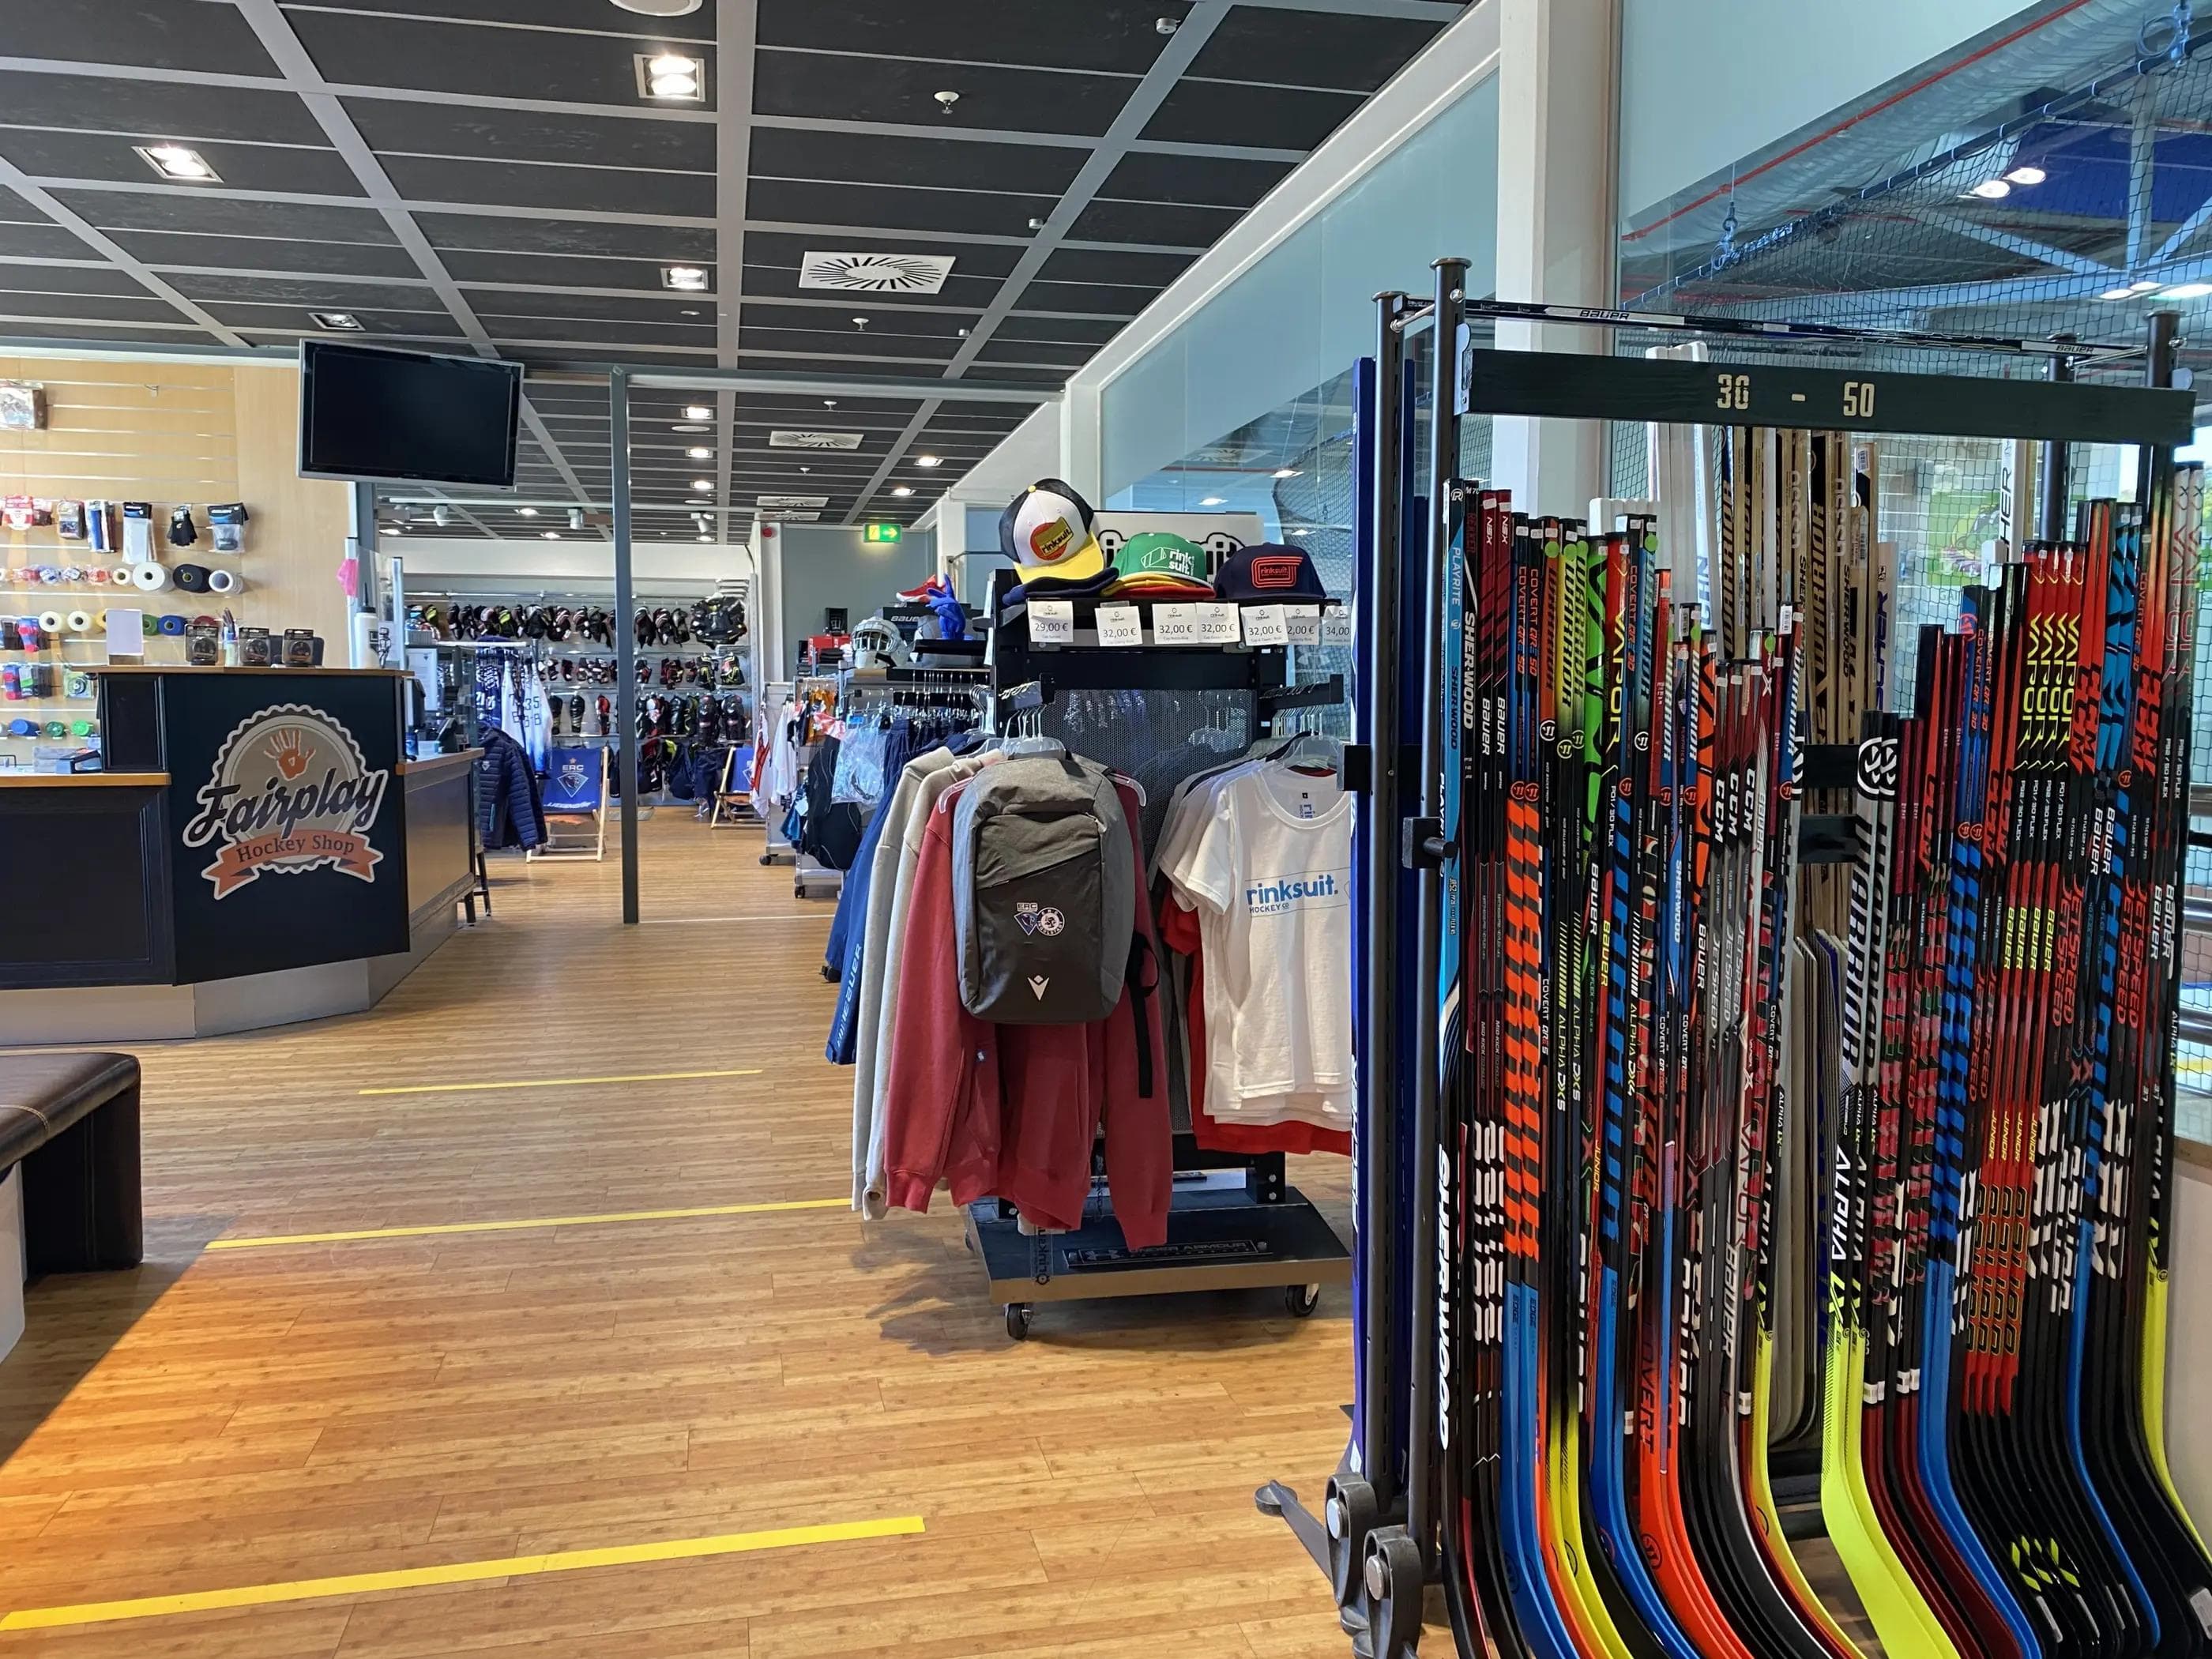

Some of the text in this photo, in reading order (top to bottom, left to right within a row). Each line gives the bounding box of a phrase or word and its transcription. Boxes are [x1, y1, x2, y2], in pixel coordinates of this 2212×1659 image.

[1717, 374, 1875, 417] 30 - 50
[1451, 547, 1462, 607] PLAYRITE
[1518, 566, 1528, 620] COVERT
[1529, 568, 1539, 624] COVERT
[1629, 565, 1638, 621] COVERT
[1035, 623, 1069, 633] 29,00 €
[1103, 629, 1129, 638] 32,00
[1159, 624, 1194, 635] 32,00 €
[1201, 623, 1227, 634] 32,00
[1249, 625, 1282, 637] 32,00 €
[1288, 626, 1305, 636] 2,00
[1326, 626, 1350, 637] 34,00
[1562, 562, 1577, 707] WARRIOR
[1604, 608, 1626, 754] VAPOR
[1689, 650, 1700, 762] WARRIOR
[2016, 612, 2043, 750] VAPOR
[2030, 612, 2056, 750] VAPOR
[2042, 612, 2069, 750] VAPOR
[2056, 613, 2082, 751] VAPOR
[1481, 698, 1492, 755] BAUER
[1497, 696, 1507, 755] BAUER
[188, 768, 384, 842] Fairplay
[1715, 778, 1725, 843] CCM
[1728, 772, 1740, 837] CCM
[1743, 768, 1755, 832] CCM
[236, 834, 355, 863] Hockey Shop
[2090, 807, 2103, 875] BAUER
[2101, 807, 2116, 875] BAUER
[1246, 875, 1339, 906] rinksuit.
[1249, 904, 1281, 914] HOCKEY
[1589, 862, 1599, 935] BAUER
[2150, 885, 2163, 959] BAUER
[1601, 920, 1611, 987] BAUER
[1696, 923, 1706, 989] BAUER
[1732, 920, 1746, 1014] JETSPEED
[2003, 906, 2014, 970] BAUER
[2015, 906, 2027, 969] BAUER
[2030, 906, 2041, 970] BAUER
[2044, 908, 2055, 972] BAUER
[2052, 876, 2072, 1027] JETSPEED
[2063, 873, 2084, 1025] JETSPEED
[2116, 874, 2135, 1025] JETSPEED
[2128, 878, 2147, 1028] JETSPEED
[1710, 932, 1721, 1029] JETSPEED
[1723, 924, 1734, 1021] JETSPEED
[1558, 1013, 1567, 1067] ALPHA
[1629, 1003, 1638, 1057] ALPHA
[1768, 1005, 1777, 1041] COVERT
[1592, 1139, 1601, 1193] JUNIOR
[1988, 1109, 1997, 1160] JUNIOR
[2001, 1111, 2011, 1161] JUNIOR
[2014, 1112, 2024, 1162] JUNIOR
[2028, 1112, 2038, 1163] JUNIOR
[1833, 1144, 1852, 1262] ALPHA
[1721, 1243, 1737, 1359] BAUER
